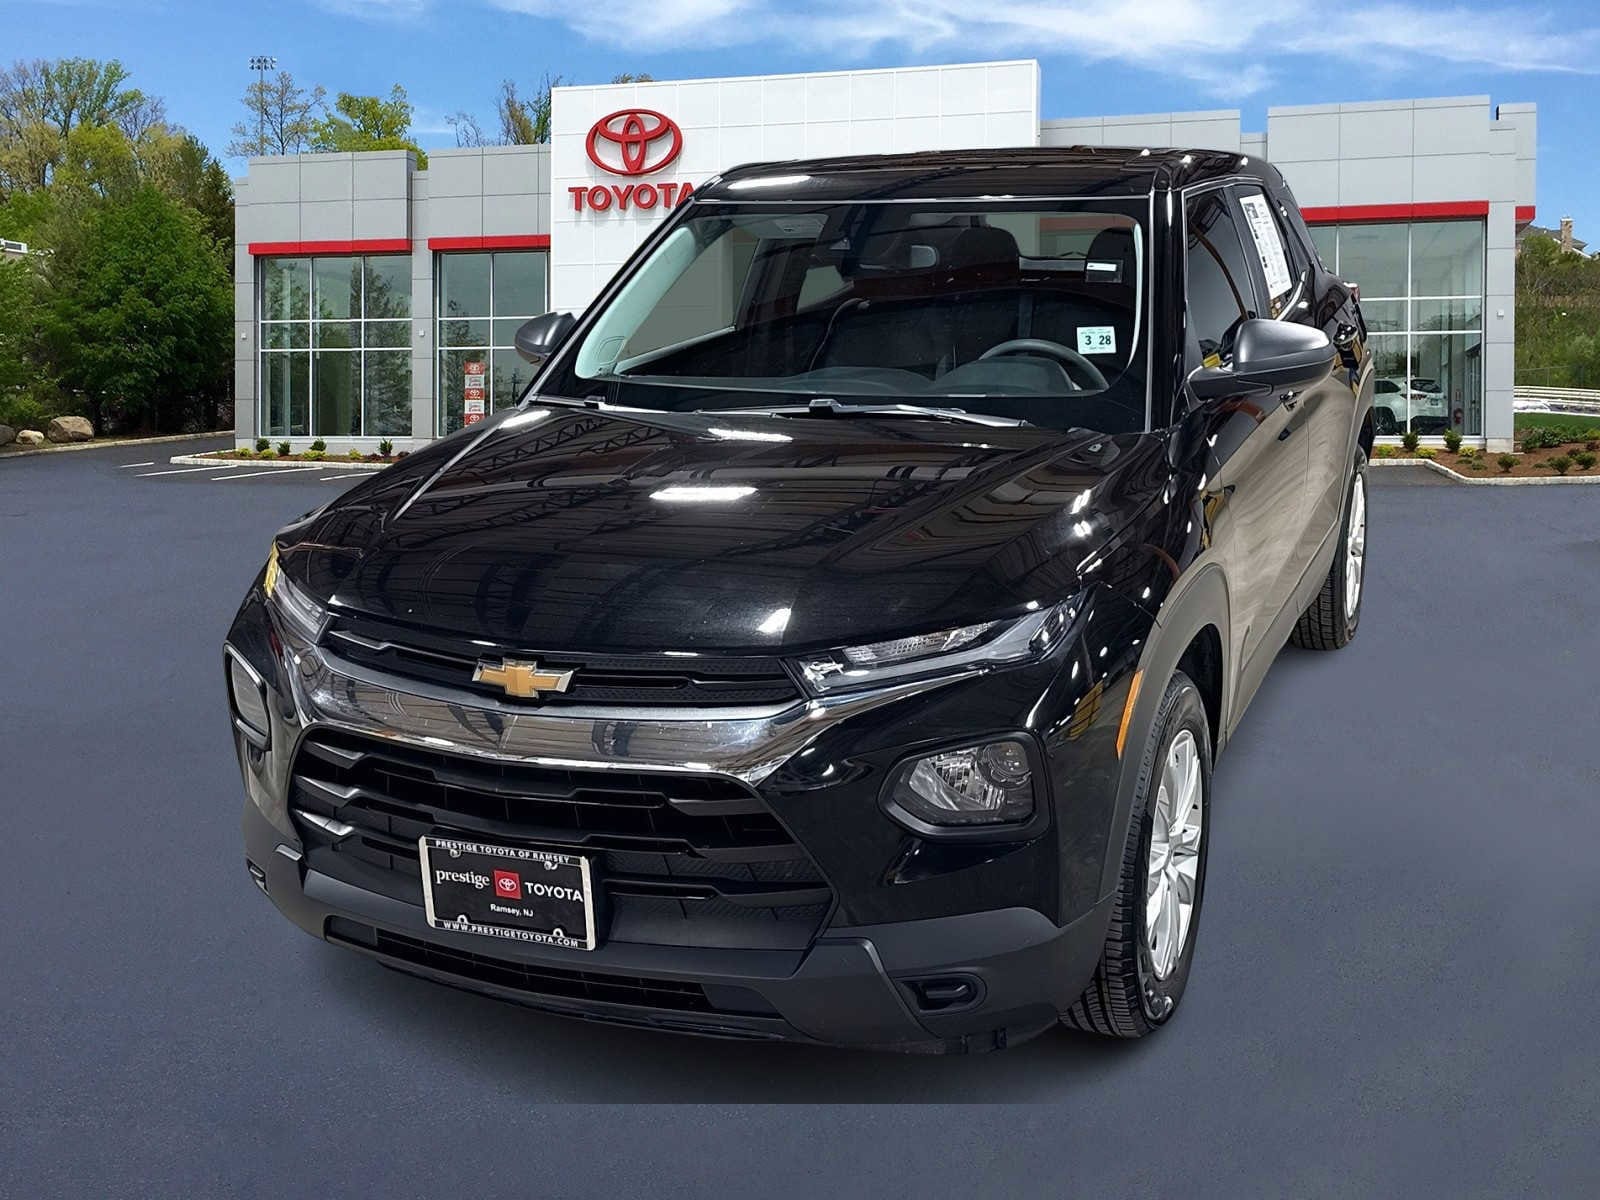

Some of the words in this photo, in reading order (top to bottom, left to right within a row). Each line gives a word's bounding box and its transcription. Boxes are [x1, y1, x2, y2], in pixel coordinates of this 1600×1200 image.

[568, 182, 697, 212] TOYOTA
[1084, 335, 1092, 346] 3
[1098, 335, 1112, 346] 28
[435, 839, 478, 852] PRESTIGE
[480, 845, 516, 857] TOYOTA
[518, 850, 530, 859] OF
[532, 851, 570, 865] RAMSEY
[435, 869, 490, 889] prestige
[524, 881, 584, 902] TOYOTA
[490, 903, 522, 917] Ramsey,
[523, 909, 534, 918] NJ
[443, 920, 579, 948] WWW.PRESTIGETOYOTA.COM
